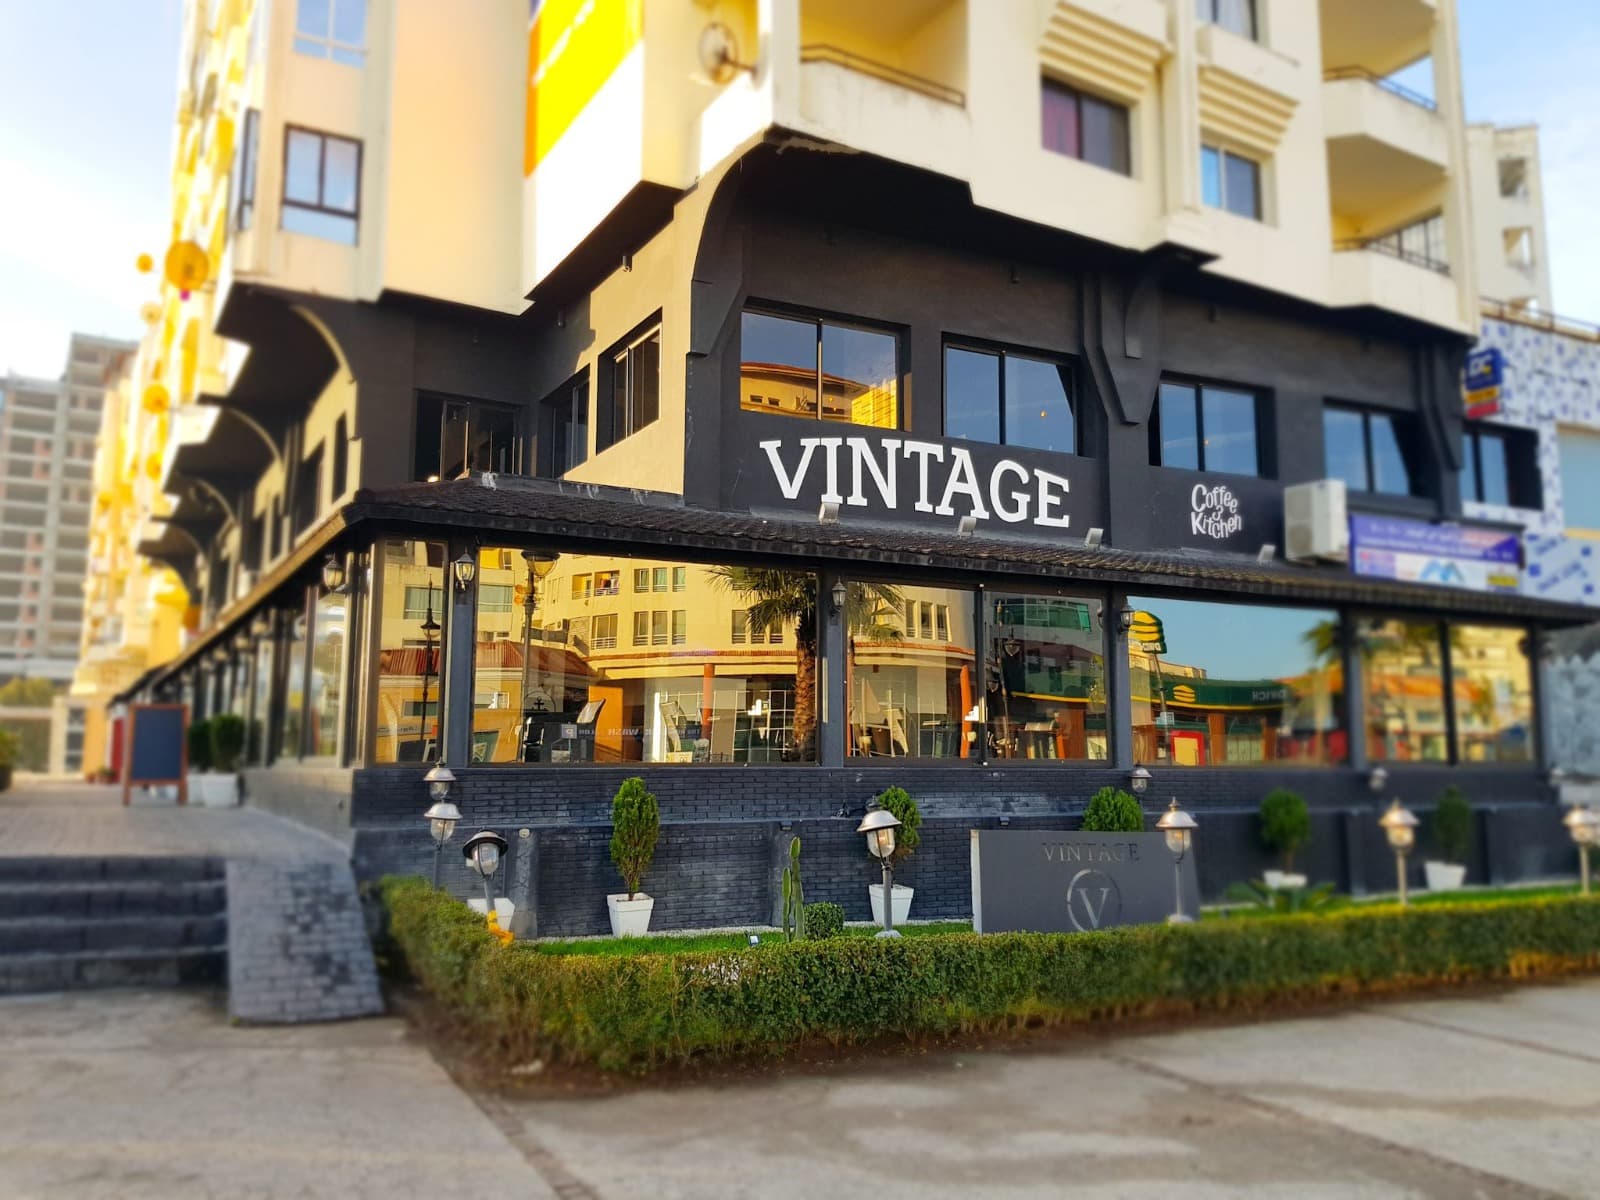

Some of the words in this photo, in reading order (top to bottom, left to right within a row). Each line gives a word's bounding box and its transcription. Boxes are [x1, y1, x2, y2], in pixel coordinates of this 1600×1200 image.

[759, 437, 1070, 528] VINTAGE
[1191, 484, 1238, 513] Coffee
[1191, 512, 1241, 538] Kitchen
[1042, 842, 1140, 861] VINTAGE
[1076, 888, 1110, 928] V
